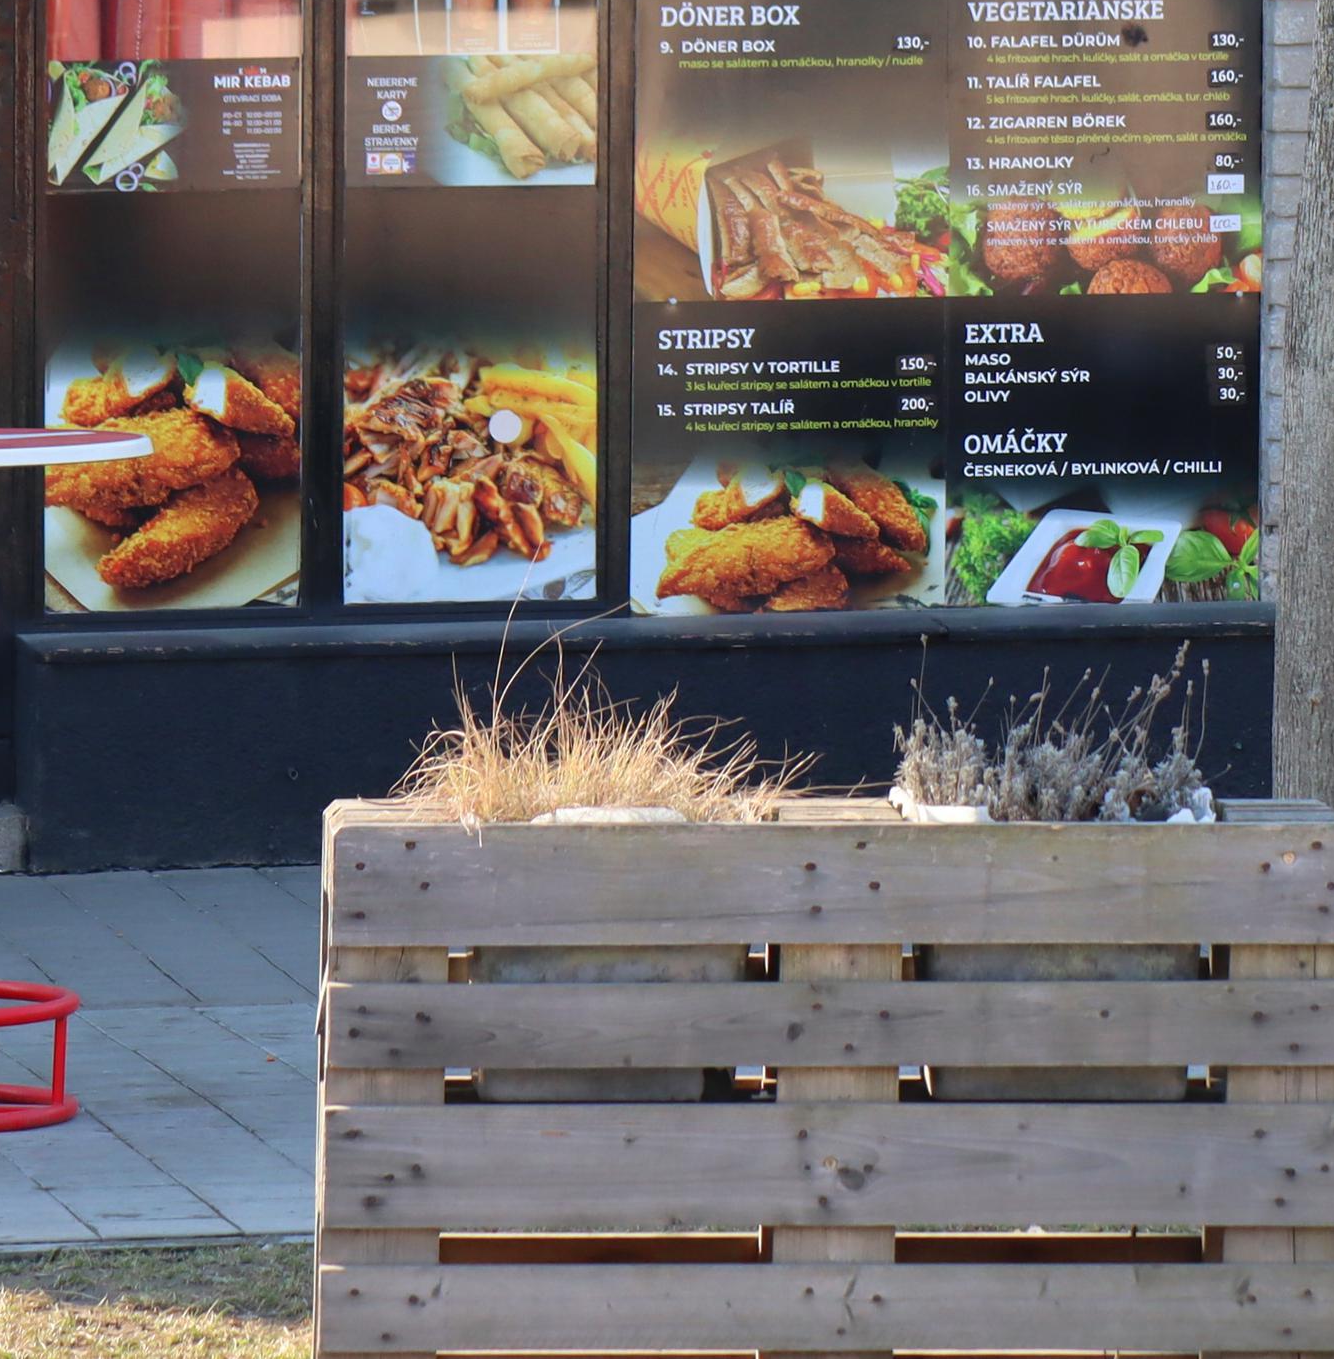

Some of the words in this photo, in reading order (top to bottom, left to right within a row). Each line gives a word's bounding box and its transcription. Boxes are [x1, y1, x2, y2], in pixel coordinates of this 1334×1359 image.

[661, 2, 745, 26] DÖNER
[751, 6, 800, 25] BOX
[661, 42, 673, 54] 9.
[682, 39, 737, 53] DÖNER
[743, 40, 775, 52] BOX
[897, 36, 929, 50] 130,-
[968, 36, 986, 48] 10.
[991, 35, 1057, 48] FALAFEL
[1062, 33, 1120, 47] DÜRÜM
[1213, 34, 1244, 47] 130,-
[214, 76, 240, 88] MIR
[245, 75, 290, 87] KEBAB
[367, 77, 418, 87] NEBEREME
[377, 90, 407, 99] KARTY
[373, 124, 411, 134] BEREME
[967, 117, 985, 129] 12.
[989, 117, 1067, 128] ZIGARREN
[1072, 113, 1126, 127] BÖREK
[1210, 114, 1241, 127] 160,-
[365, 137, 418, 147] STRAVENKY
[966, 158, 984, 169] 13.
[989, 157, 1074, 169] HRANOLKY
[967, 185, 983, 196] 16.
[988, 180, 1054, 196] SMAŽENÝ
[1058, 179, 1082, 194] SÝR
[659, 328, 755, 350] STRIPSY
[966, 323, 1044, 344] EXTRA
[966, 354, 1010, 366] MASO
[1217, 346, 1242, 360] 50,-
[657, 364, 677, 376] 14.
[686, 362, 749, 375] STRIPSY
[753, 362, 763, 374] V
[768, 360, 839, 374] TORTILLE
[965, 368, 1057, 384] BALKÁNSKÝ
[1061, 368, 1089, 382] SÝR
[1219, 368, 1243, 380] 30,-
[965, 390, 1009, 402] OLIVY
[1220, 388, 1245, 401] 30,-
[657, 404, 675, 416] 15.
[684, 403, 747, 416] STRIPSY
[751, 400, 794, 414] TALÍŘ
[901, 398, 933, 411] 200,-
[965, 428, 1067, 454] OMÁČKY
[964, 460, 1058, 476] ČESNEKOVÁ
[1071, 459, 1160, 475] BYLINKOVÁ
[1173, 460, 1221, 474] CHILLI
